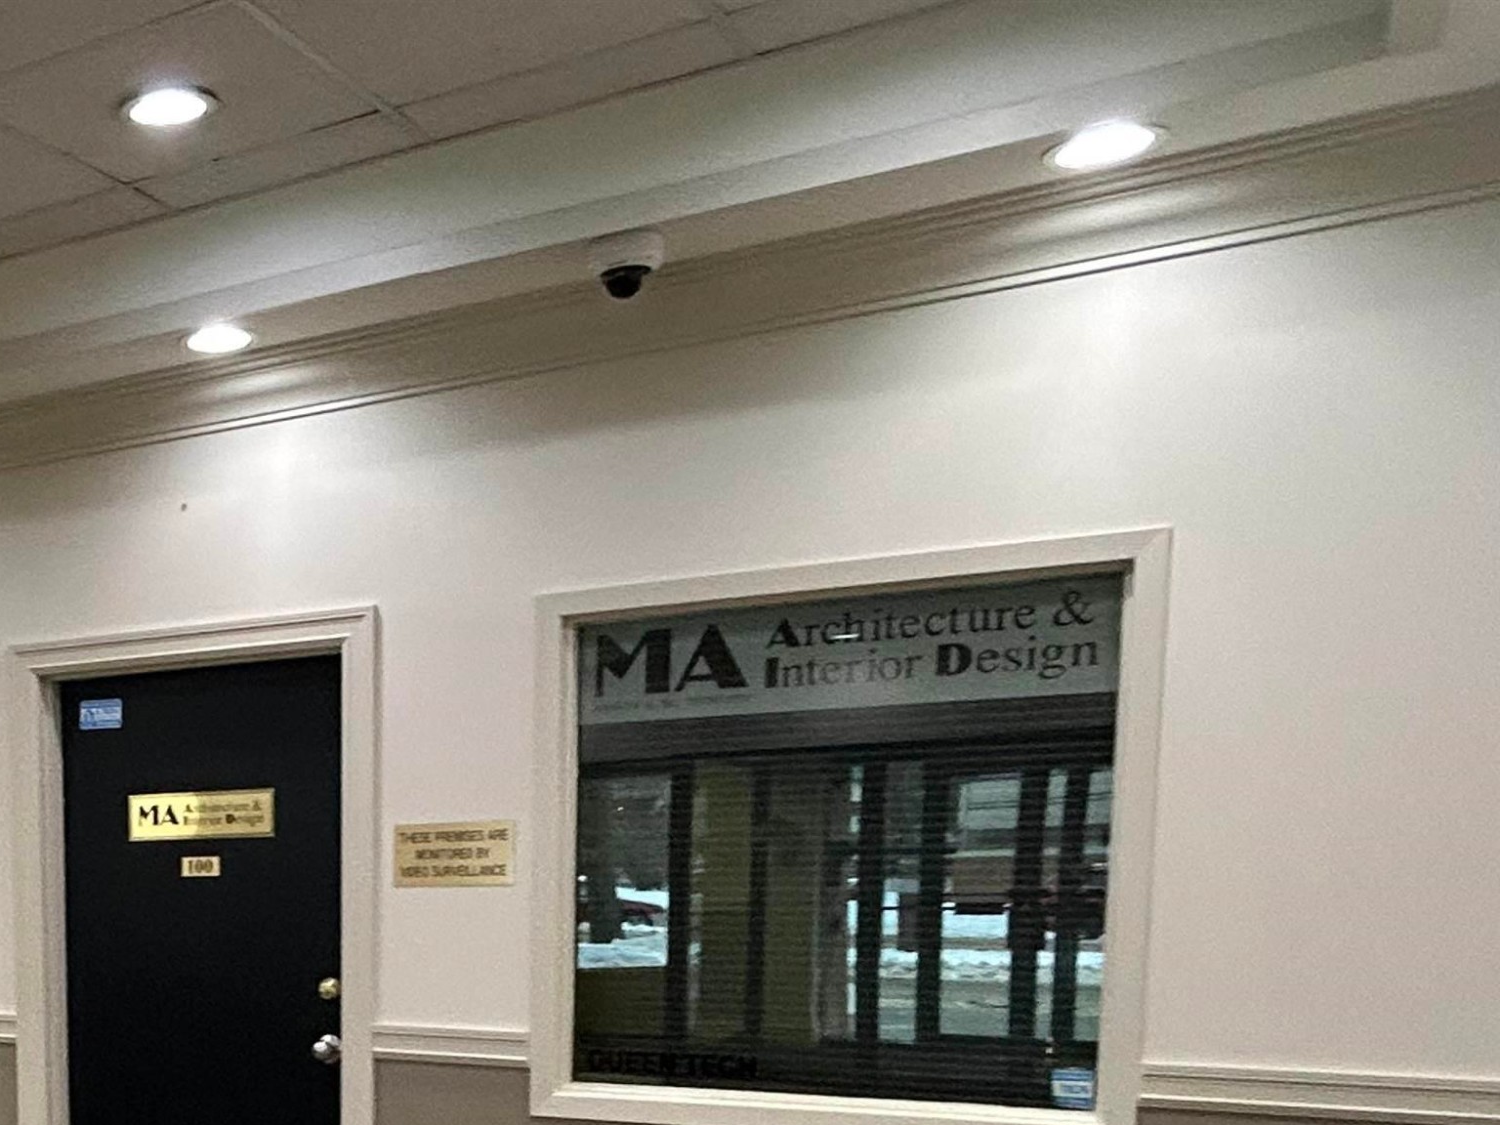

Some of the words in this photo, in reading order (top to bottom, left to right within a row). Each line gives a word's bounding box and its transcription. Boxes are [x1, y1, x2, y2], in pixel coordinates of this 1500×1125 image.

[765, 605, 1036, 648] Architecture
[1053, 590, 1094, 626] &
[595, 623, 749, 697] MA
[764, 648, 923, 688] Interior
[935, 636, 1099, 679] Design
[138, 804, 179, 827] MA
[398, 831, 432, 844] THESE
[187, 859, 214, 874] 100
